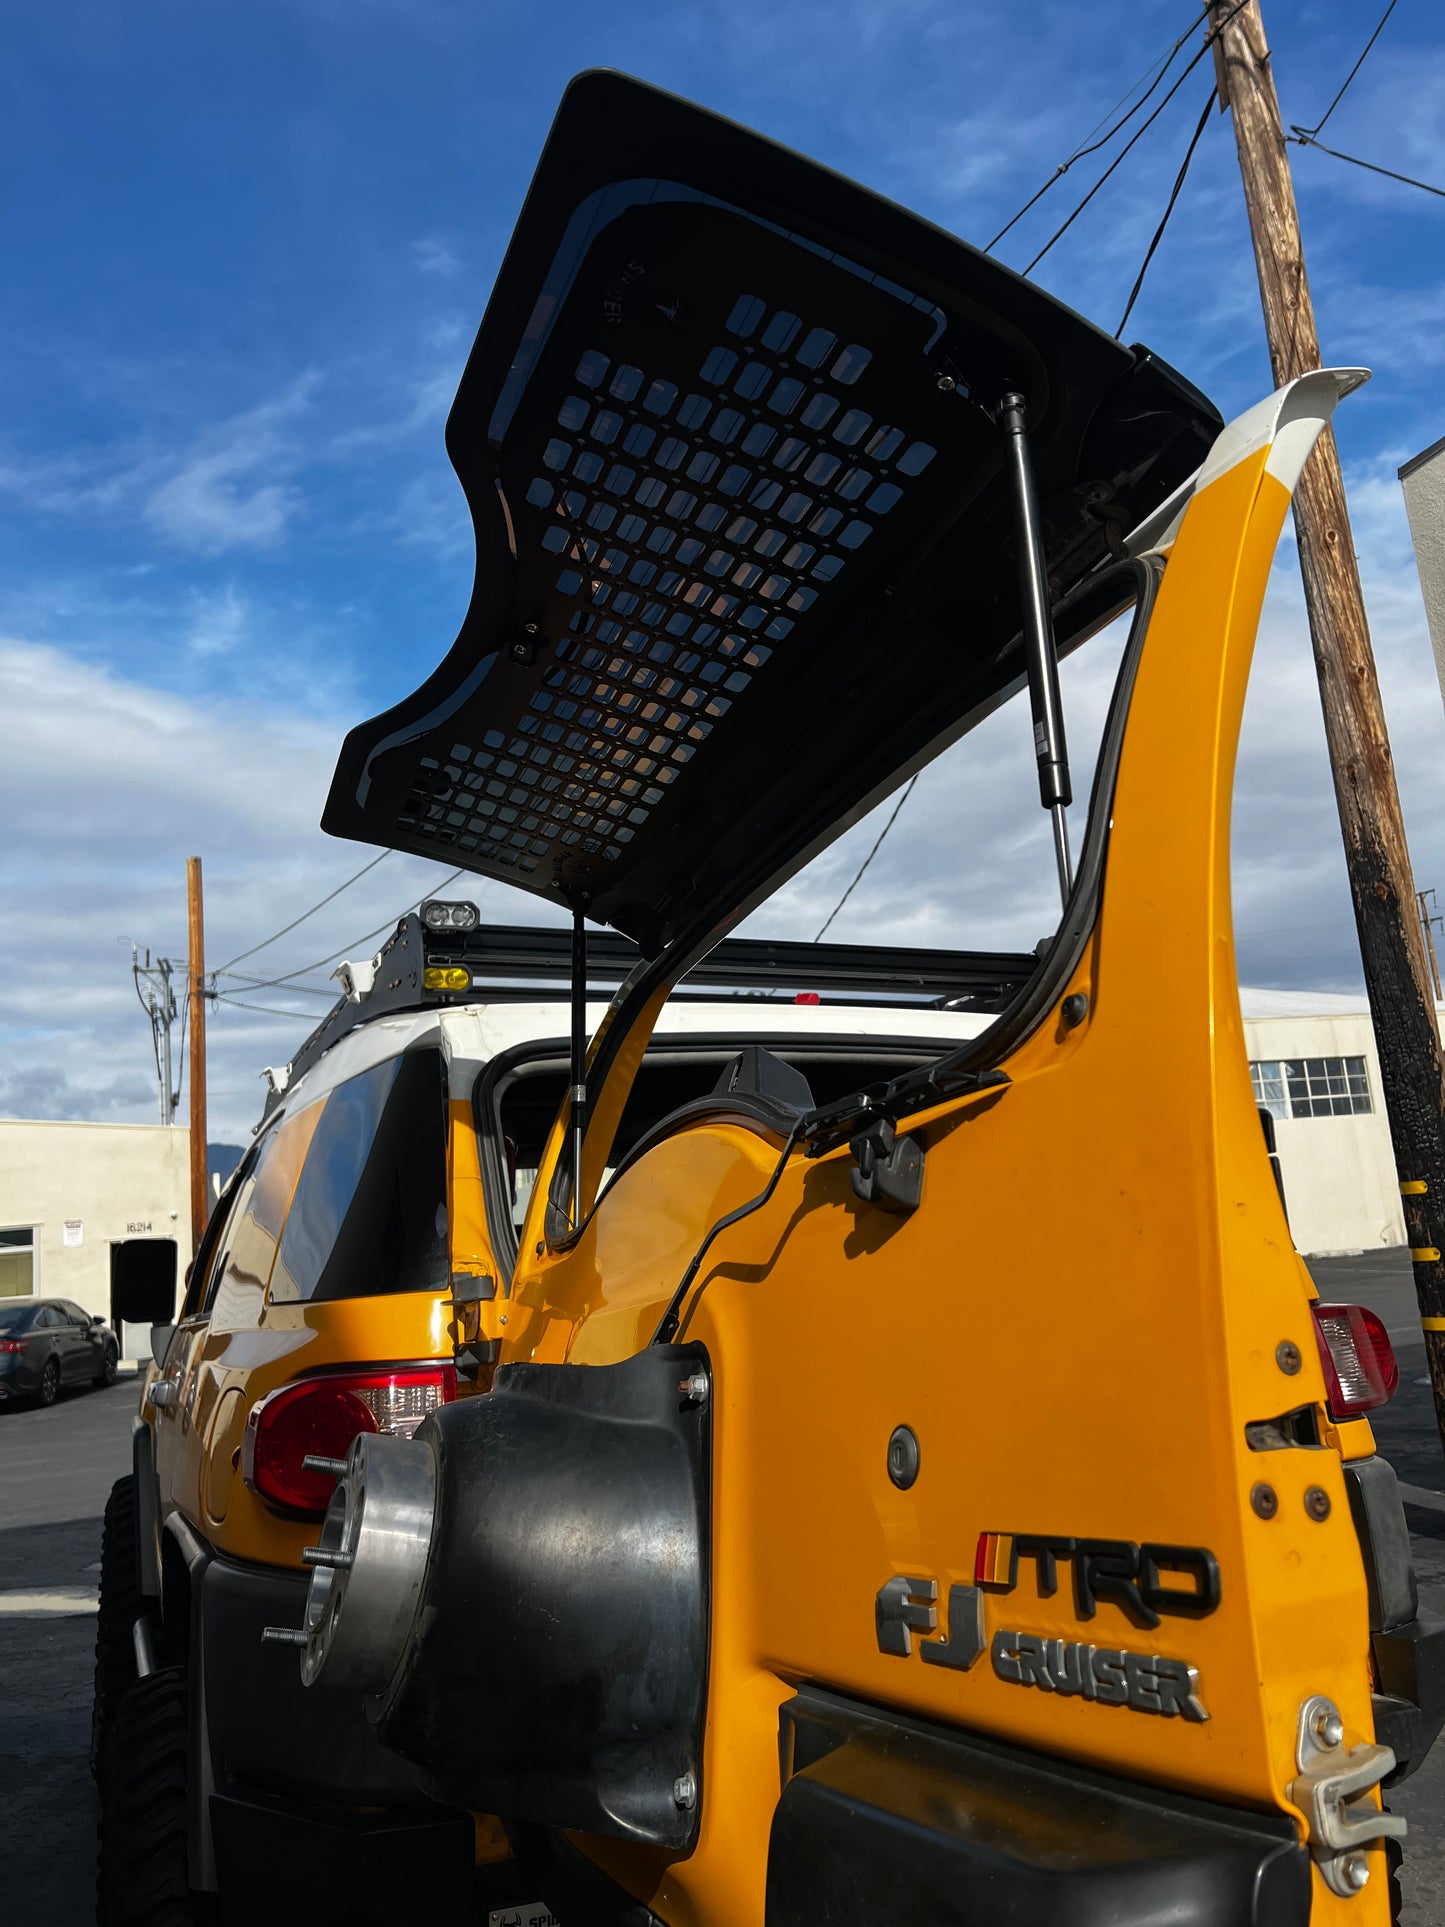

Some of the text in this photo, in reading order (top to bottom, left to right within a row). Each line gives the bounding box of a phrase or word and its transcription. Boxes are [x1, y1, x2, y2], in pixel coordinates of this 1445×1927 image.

[1013, 1533, 1221, 1631] TRD
[875, 1575, 1211, 1722] FJ CRUISER
